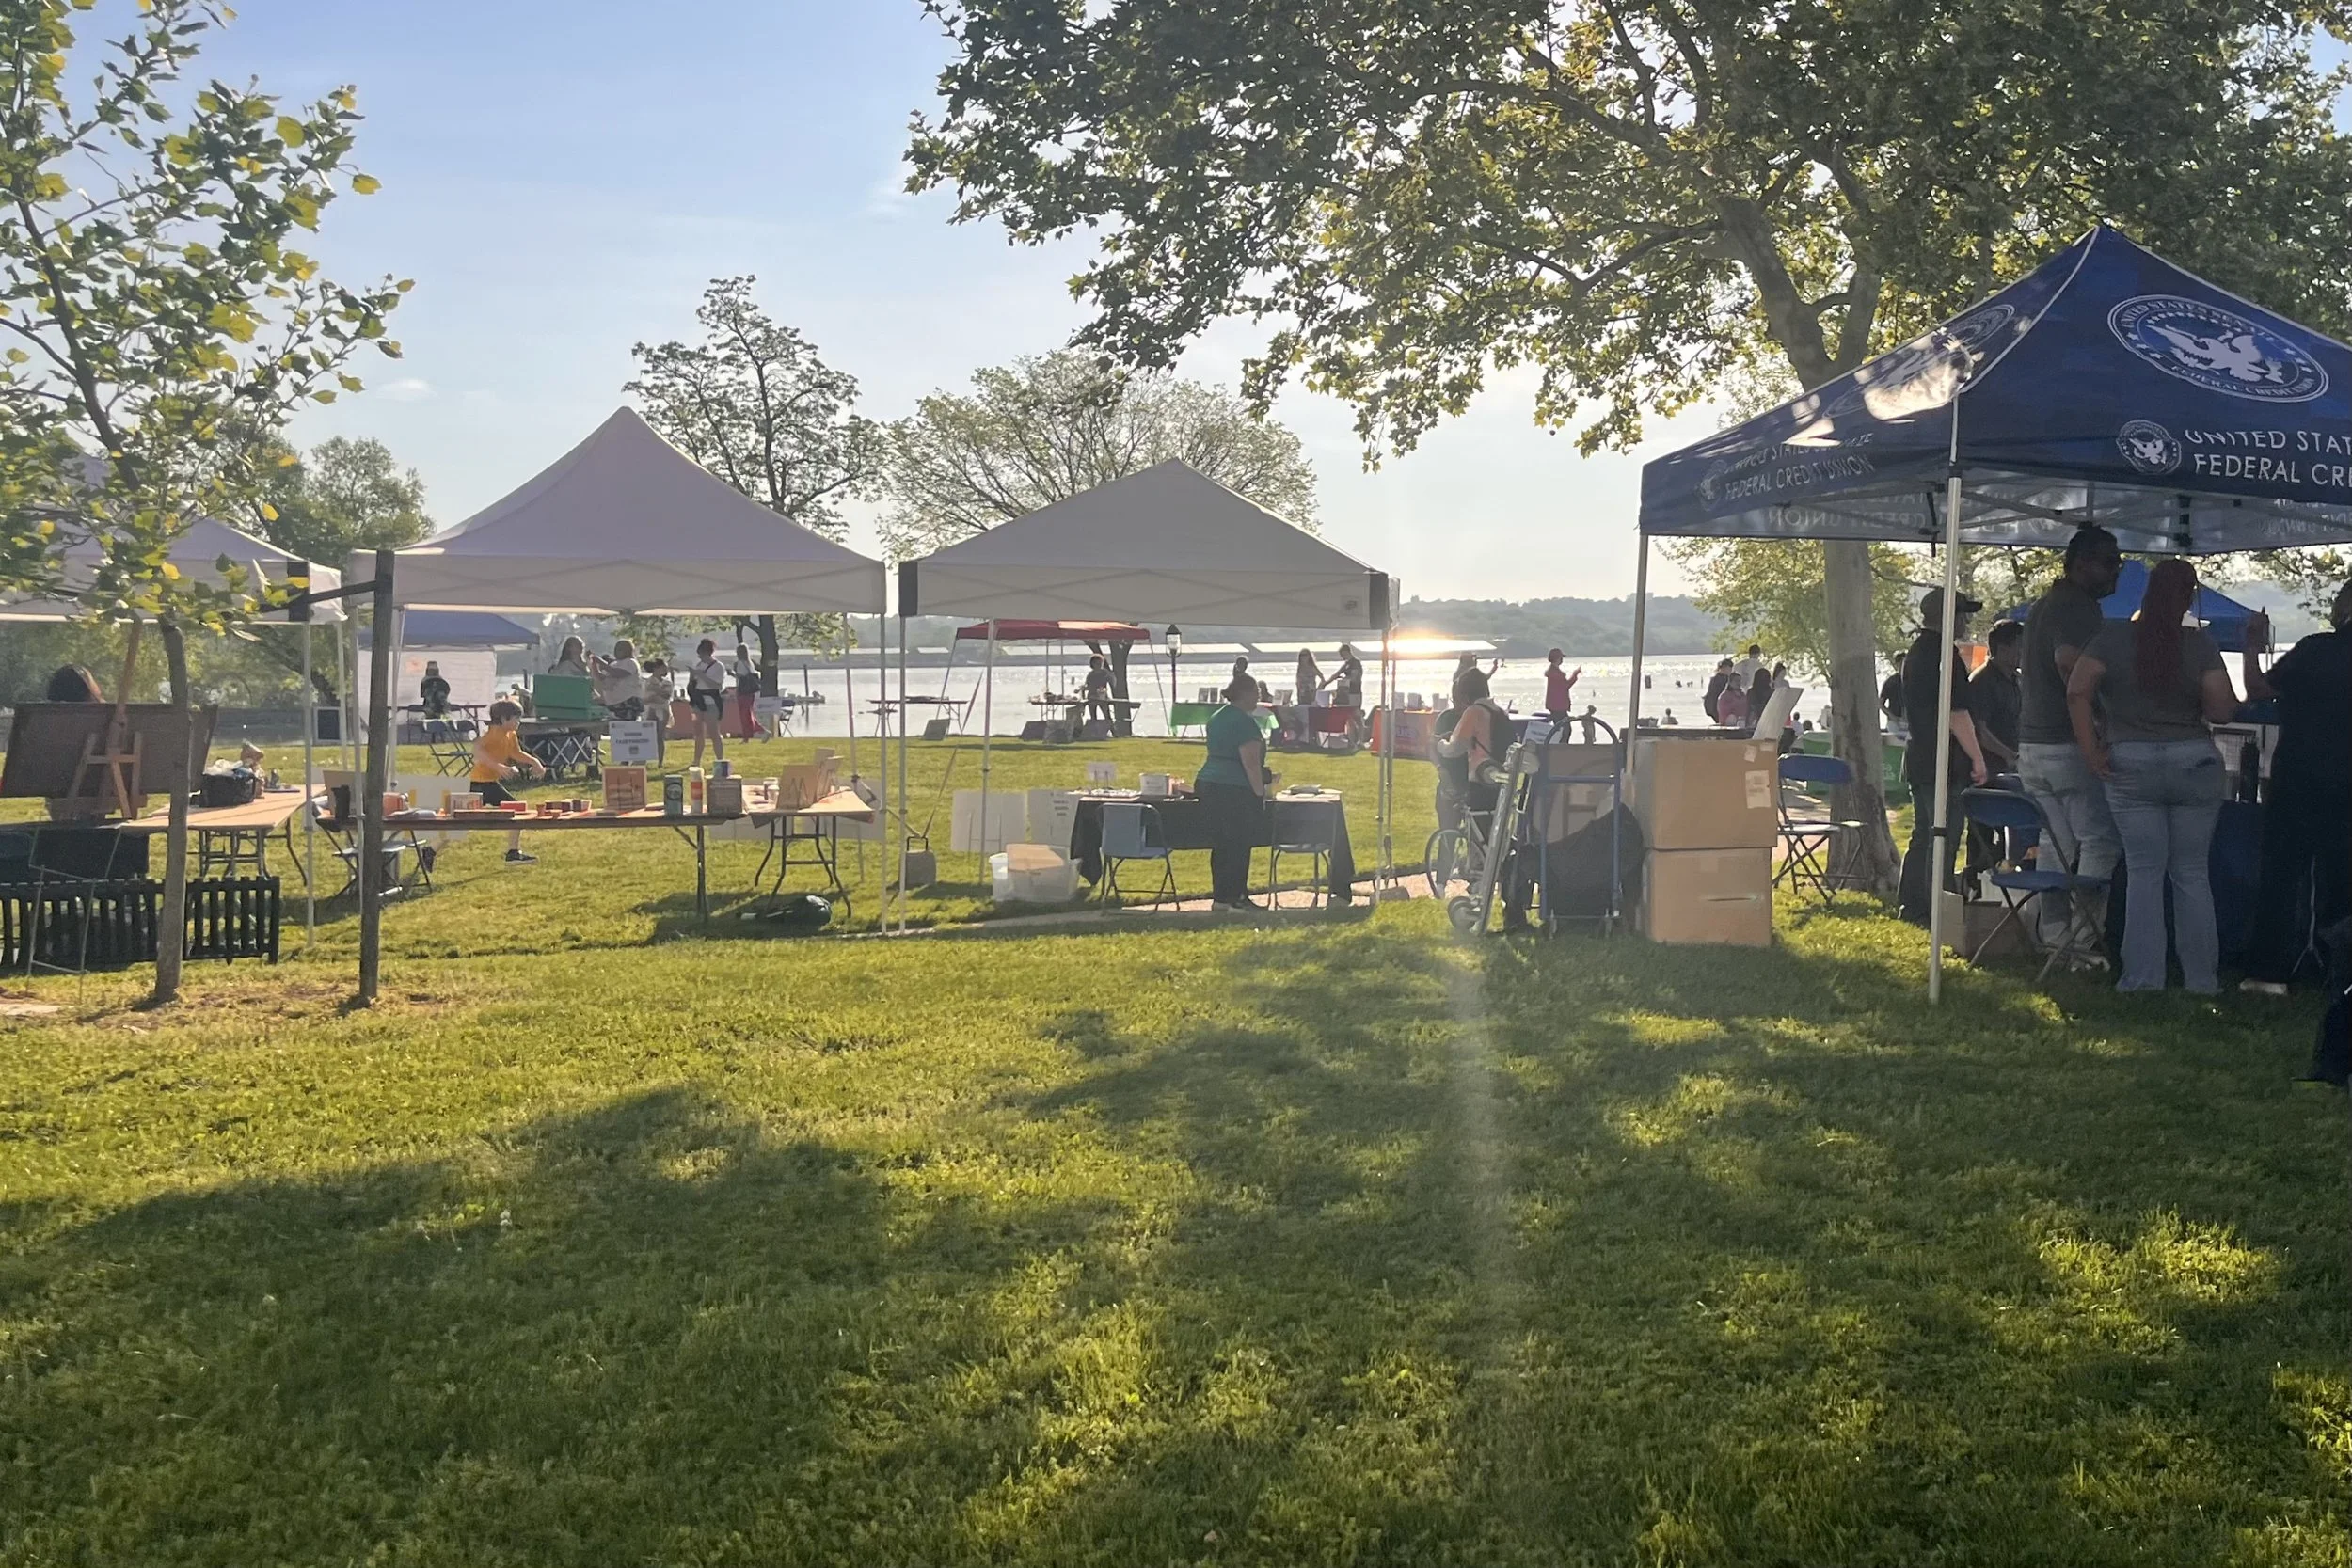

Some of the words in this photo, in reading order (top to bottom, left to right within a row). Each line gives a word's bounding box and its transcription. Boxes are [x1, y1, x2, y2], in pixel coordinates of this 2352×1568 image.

[2185, 429, 2287, 450] UNITED
[2296, 430, 2352, 456] STAT
[1724, 472, 1772, 501] FEDERAL
[1775, 462, 1823, 490] CREDIT
[1822, 453, 1876, 481] UNION
[2193, 453, 2302, 483] FEDERAL
[2311, 463, 2352, 488] CR
